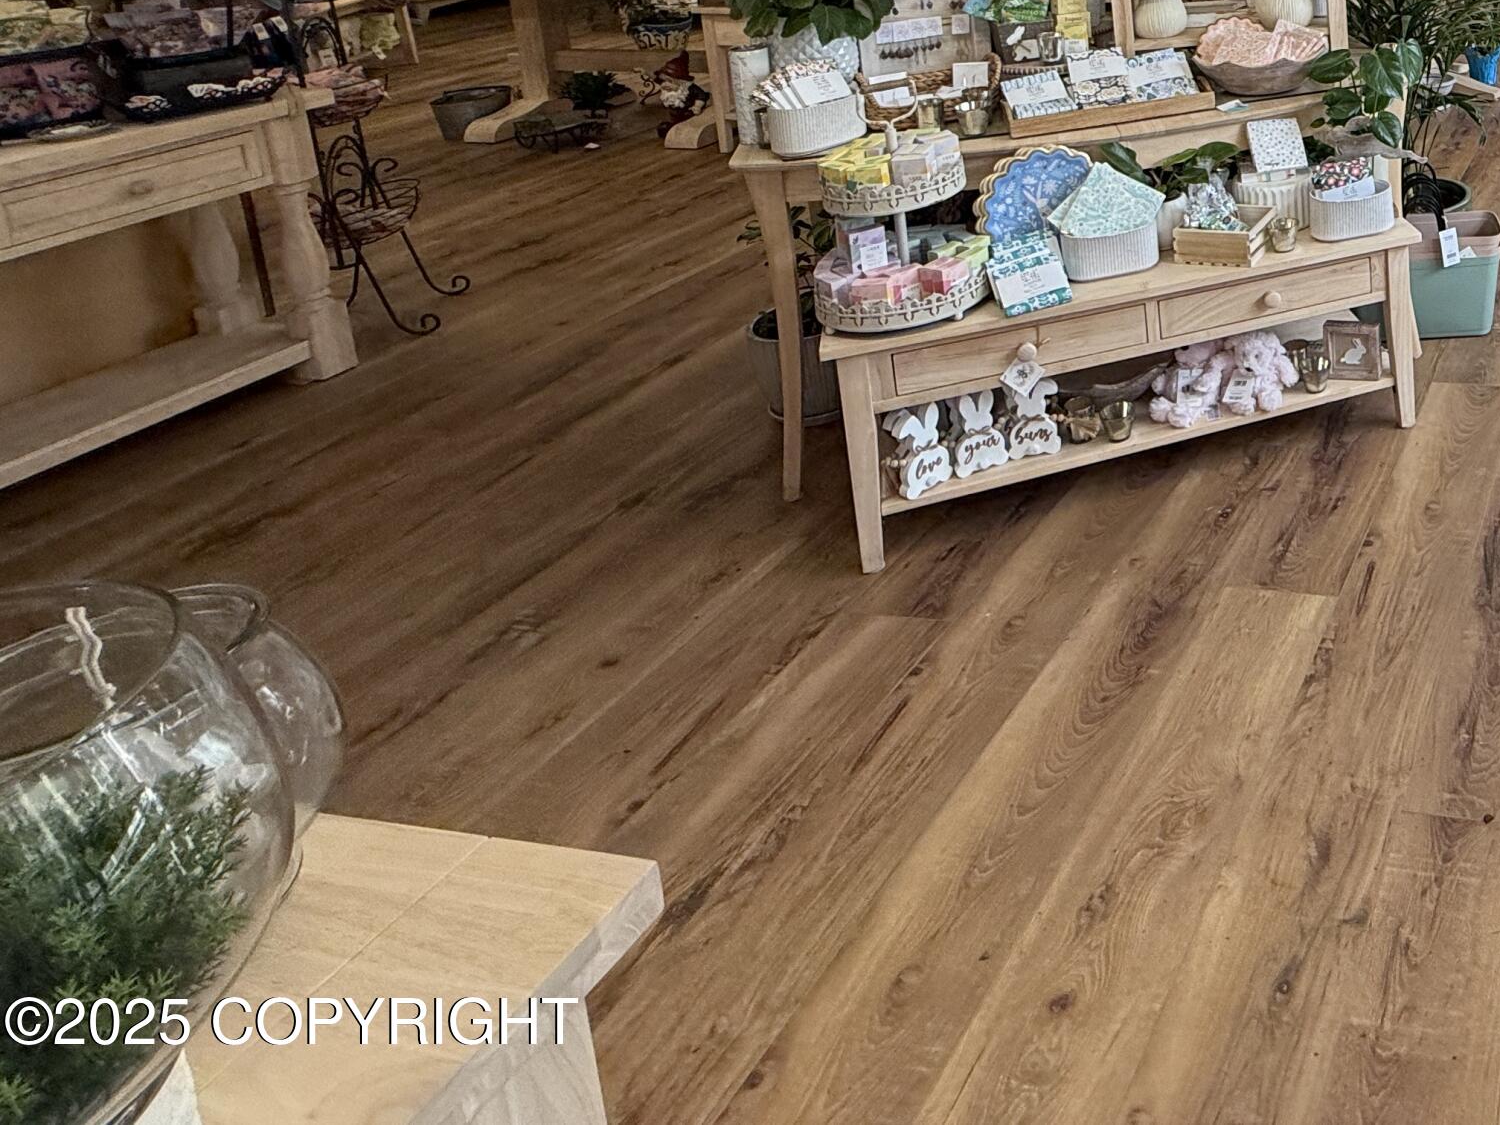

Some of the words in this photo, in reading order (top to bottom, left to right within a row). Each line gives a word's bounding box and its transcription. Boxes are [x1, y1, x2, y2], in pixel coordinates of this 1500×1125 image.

[915, 455, 943, 480] love
[963, 437, 1001, 465] your
[1014, 426, 1053, 445] buns
